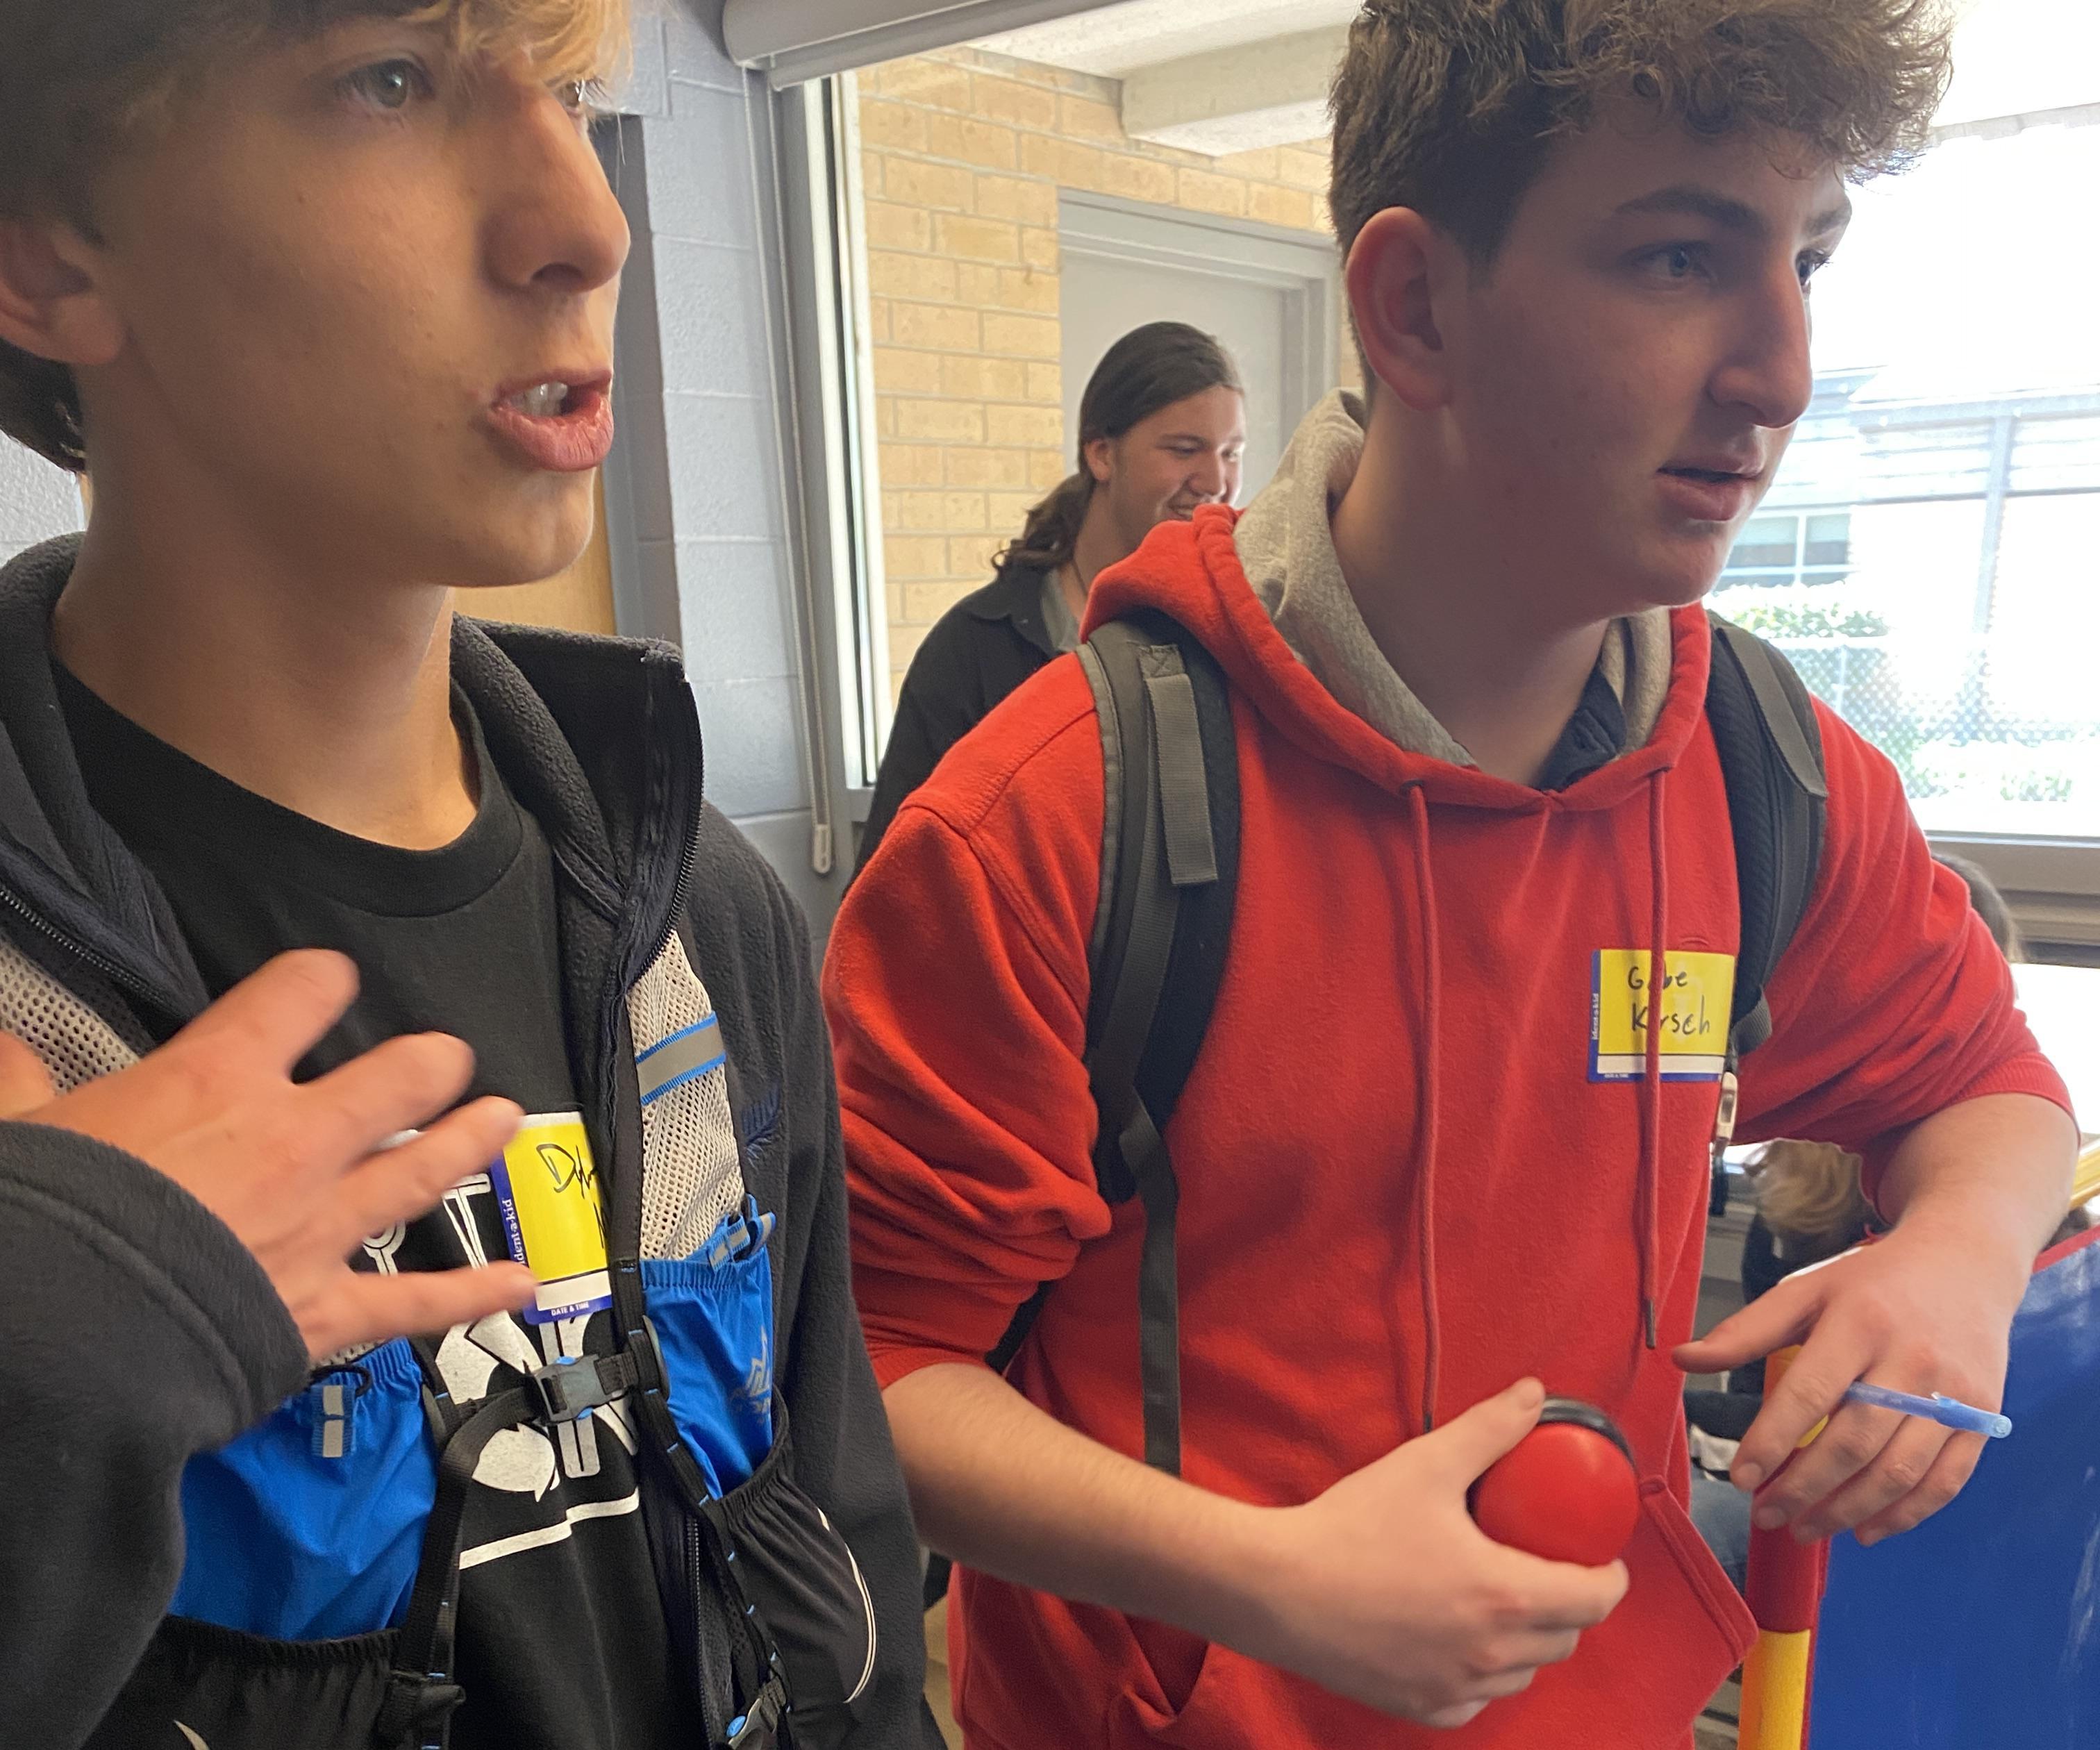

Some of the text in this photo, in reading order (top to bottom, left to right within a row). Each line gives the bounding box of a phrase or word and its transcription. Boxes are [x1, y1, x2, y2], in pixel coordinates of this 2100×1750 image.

[1628, 960, 1688, 990] Gbe
[1632, 994, 1710, 1035] Krsch
[551, 1306, 568, 1316] DATE
[575, 1301, 589, 1311] TIME
